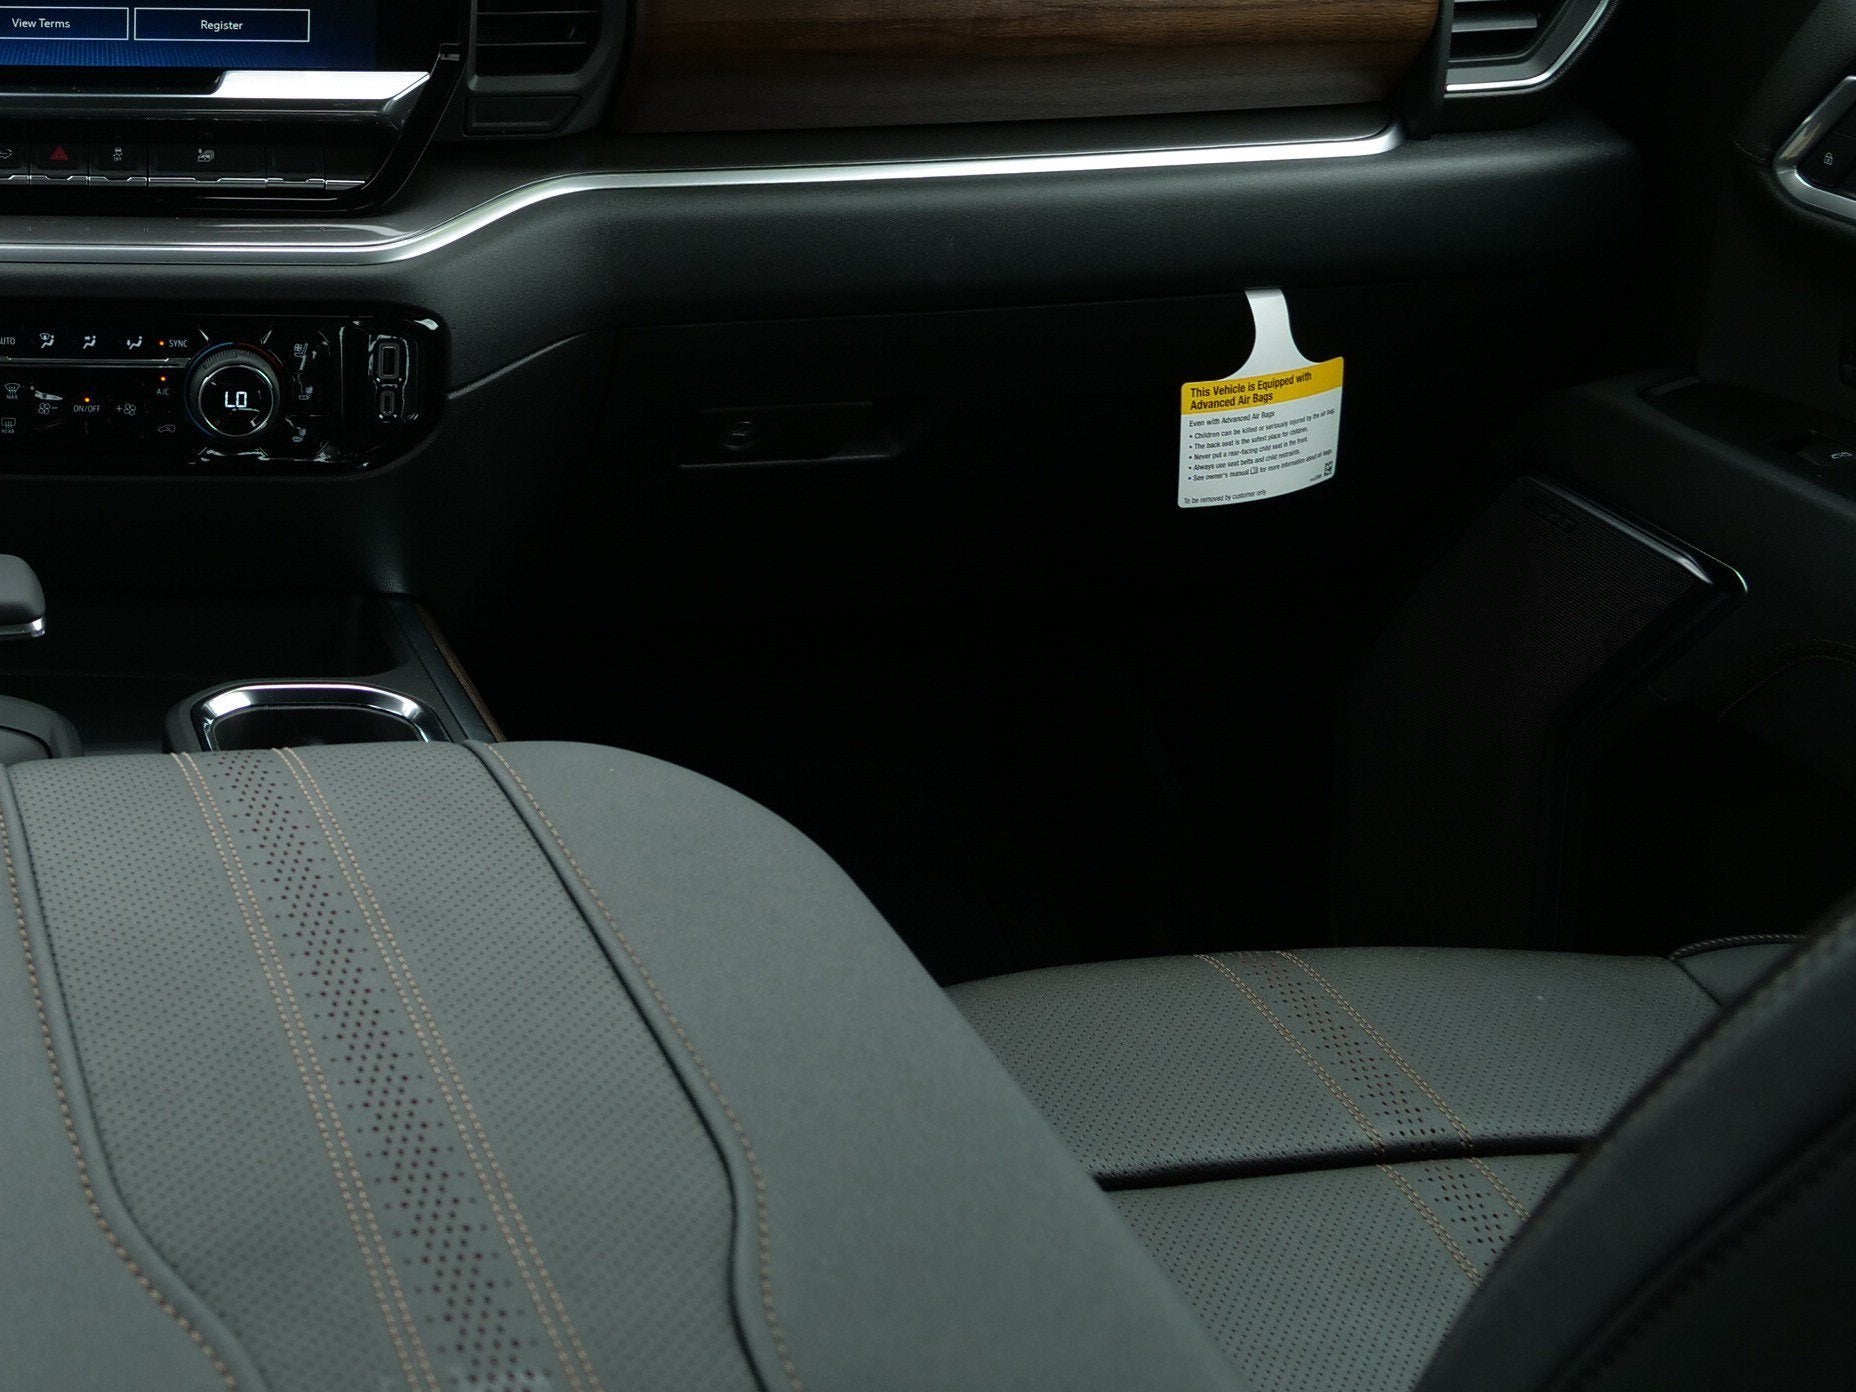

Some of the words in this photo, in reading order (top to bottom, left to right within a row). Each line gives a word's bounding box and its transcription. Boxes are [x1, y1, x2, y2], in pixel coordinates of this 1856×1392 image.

[11, 17, 37, 29] View
[39, 18, 70, 29] Terms
[200, 19, 244, 33] Register
[168, 338, 188, 349] SYNC
[1190, 387, 1211, 398] This
[1213, 383, 1246, 396] Vehicle
[1247, 382, 1256, 392] is
[1258, 374, 1295, 390] Equipped
[1295, 371, 1312, 383] with
[156, 387, 170, 397] A/C
[1190, 396, 1236, 410] Advanced
[1238, 394, 1251, 406] Air
[1252, 392, 1274, 404] Bags
[73, 404, 101, 413] ON/OFF
[1189, 419, 1205, 428] Even
[1206, 418, 1221, 426] with
[1221, 413, 1251, 424] Advanced
